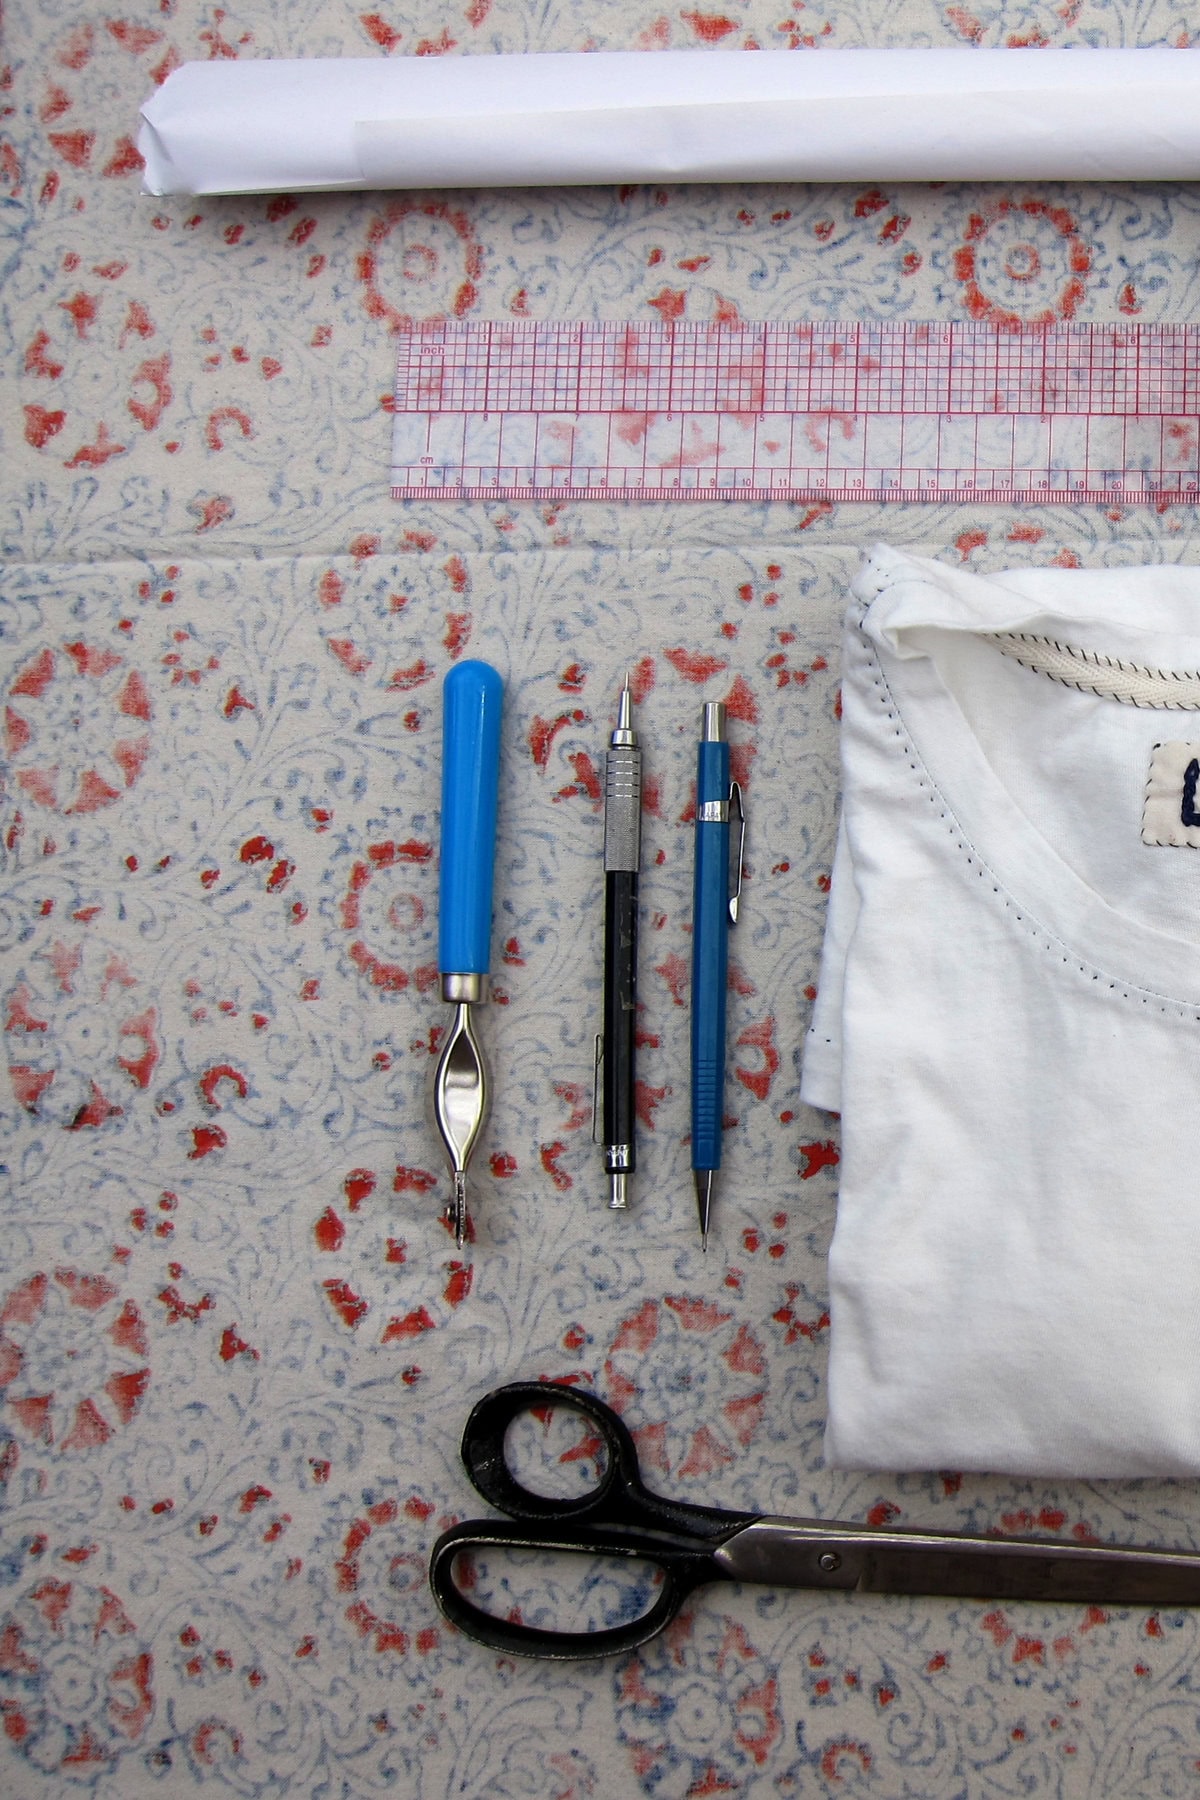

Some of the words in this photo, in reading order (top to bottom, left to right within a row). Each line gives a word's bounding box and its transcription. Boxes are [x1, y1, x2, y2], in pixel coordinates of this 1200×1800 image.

[483, 335, 488, 343] 1
[573, 335, 579, 343] 2
[665, 334, 671, 343] 3
[850, 335, 856, 343] 5
[943, 335, 949, 343] 6
[1130, 336, 1136, 344] 8
[420, 346, 445, 355] inch
[483, 413, 488, 421] 8
[575, 413, 580, 421] 7
[667, 413, 672, 422] 6
[760, 413, 765, 422] 5
[946, 414, 952, 423] 3
[1040, 415, 1046, 423] 2
[1135, 416, 1139, 424] 1
[420, 456, 434, 464] cm
[420, 477, 425, 485] 1
[456, 477, 462, 486] 2
[491, 477, 497, 486] 3
[527, 478, 534, 486] 4
[563, 478, 570, 486] 5
[600, 478, 606, 486] 6
[636, 478, 643, 486] 7
[673, 478, 679, 486] 8
[709, 478, 716, 487] 9
[742, 478, 751, 487] 10
[779, 479, 788, 487] 11
[816, 479, 825, 487] 12
[853, 479, 862, 487] 13
[890, 479, 898, 488] 14
[927, 479, 936, 488] 15
[1001, 480, 1010, 489] 17
[1038, 480, 1047, 489] 18
[1075, 481, 1084, 489] 19
[1112, 481, 1121, 490] 20
[1149, 482, 1157, 490] 21
[1186, 482, 1196, 490] 22
